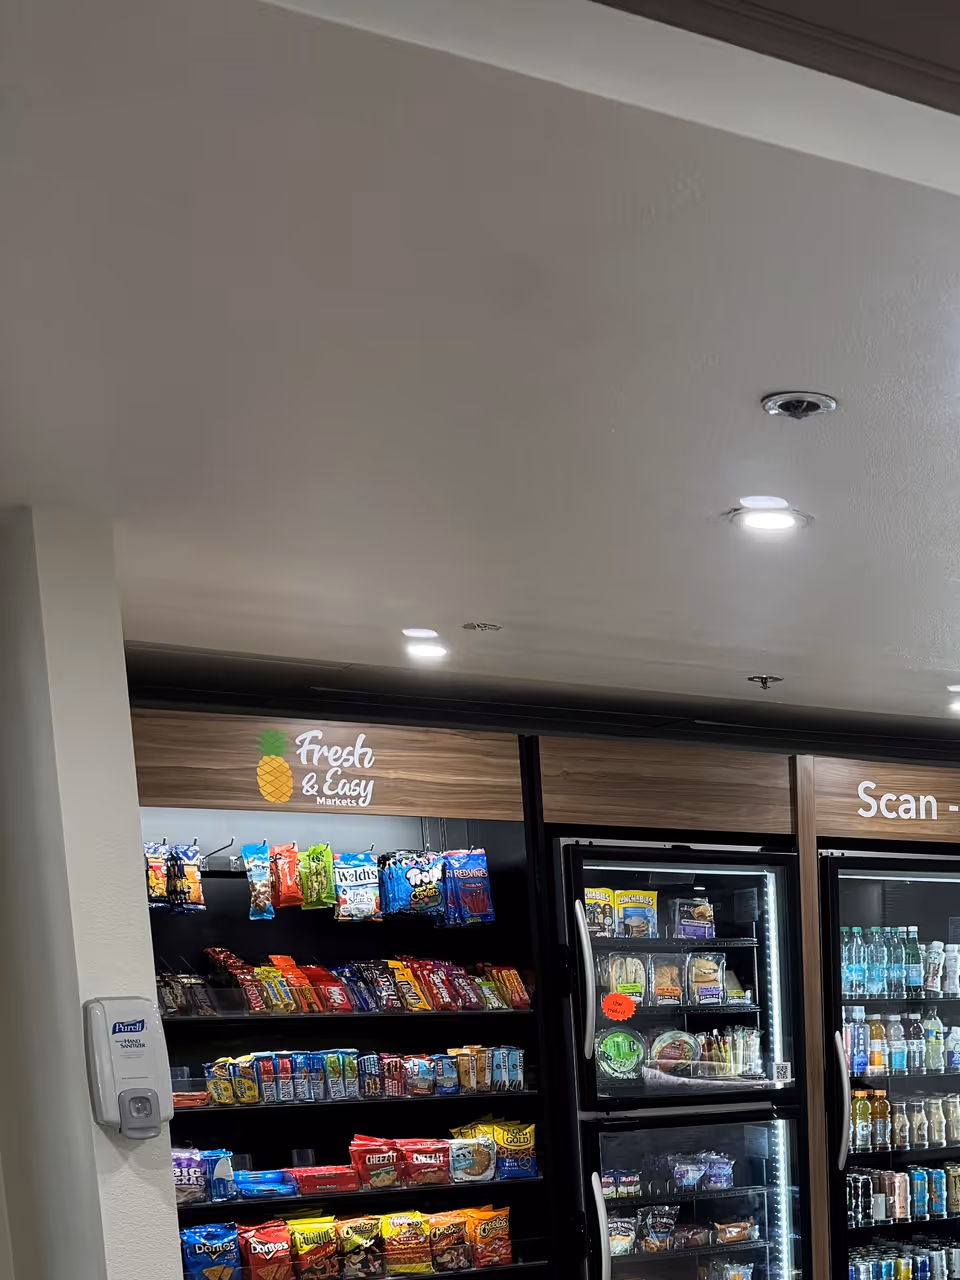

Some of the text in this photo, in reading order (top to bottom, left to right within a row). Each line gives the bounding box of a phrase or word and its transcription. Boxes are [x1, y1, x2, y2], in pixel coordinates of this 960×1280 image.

[295, 729, 375, 768] Fresh
[302, 767, 375, 807] & Easy
[316, 797, 357, 807] Markets
[856, 780, 938, 820] Scan
[337, 867, 378, 883] Welch's
[115, 1022, 142, 1032] Purell
[506, 1136, 529, 1144] GOLD
[172, 1167, 200, 1177] BIG
[173, 1176, 206, 1186] EXAS
[195, 1241, 236, 1253] Doritos
[251, 1240, 289, 1254] Doritos
